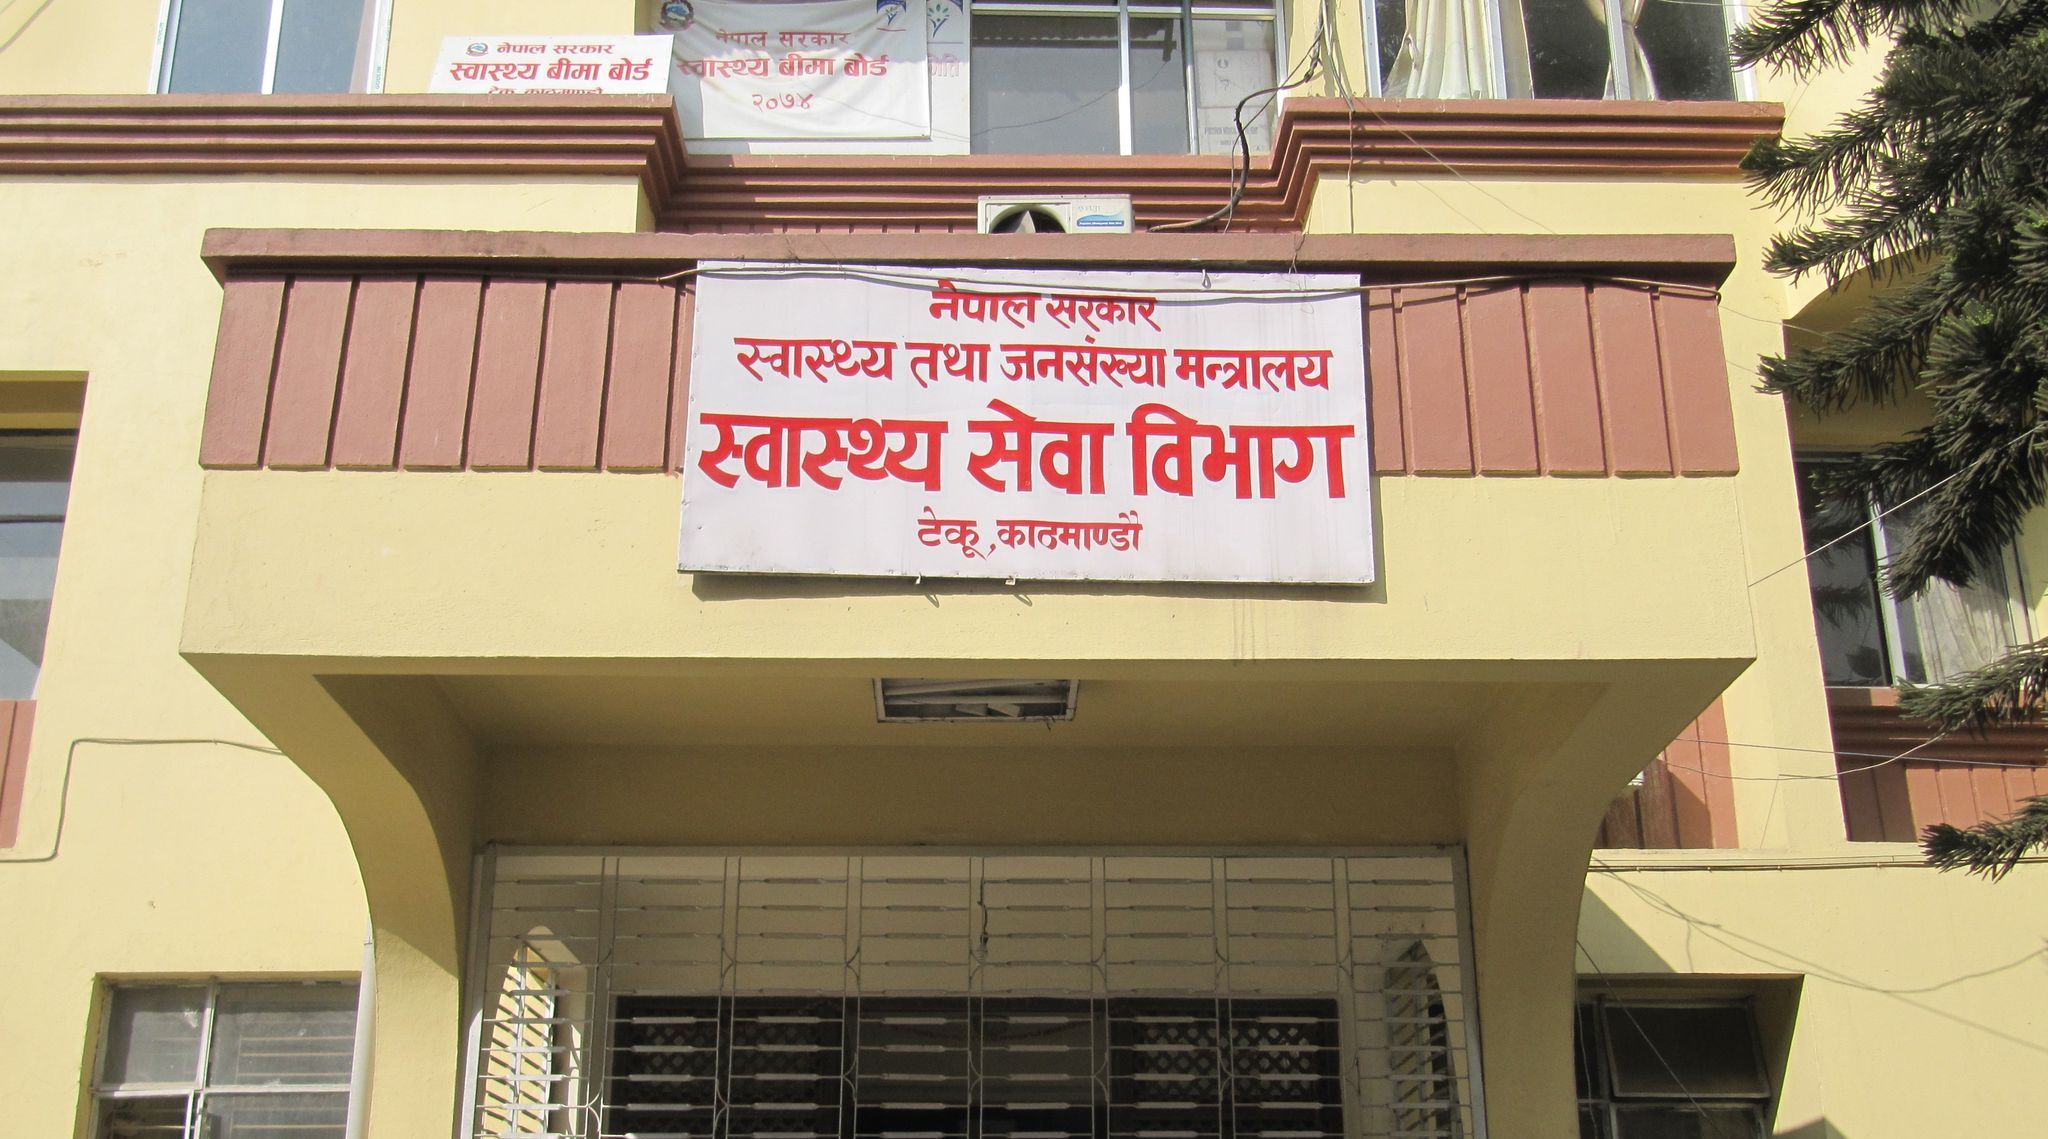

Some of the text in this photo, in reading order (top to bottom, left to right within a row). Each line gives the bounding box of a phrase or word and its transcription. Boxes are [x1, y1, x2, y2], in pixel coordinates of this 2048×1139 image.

[496, 42, 615, 55] नेपाल सरकार
[715, 29, 850, 49] नेपाल सरकार
[450, 57, 653, 81] स्वास्थ्य बीमा बोर्ड
[677, 52, 889, 78] स्वास्थ्य बीमा बोर्ड
[752, 92, 813, 111] २०७४
[929, 279, 1162, 332] नेपाल सरकार
[734, 334, 1334, 393] स्वास्थ्य तथा जनसंख्या मन्त्रालय
[699, 399, 1355, 500] स्वास्थ्य सेवा विभाग
[996, 510, 1143, 551] काठमाण्डौ
